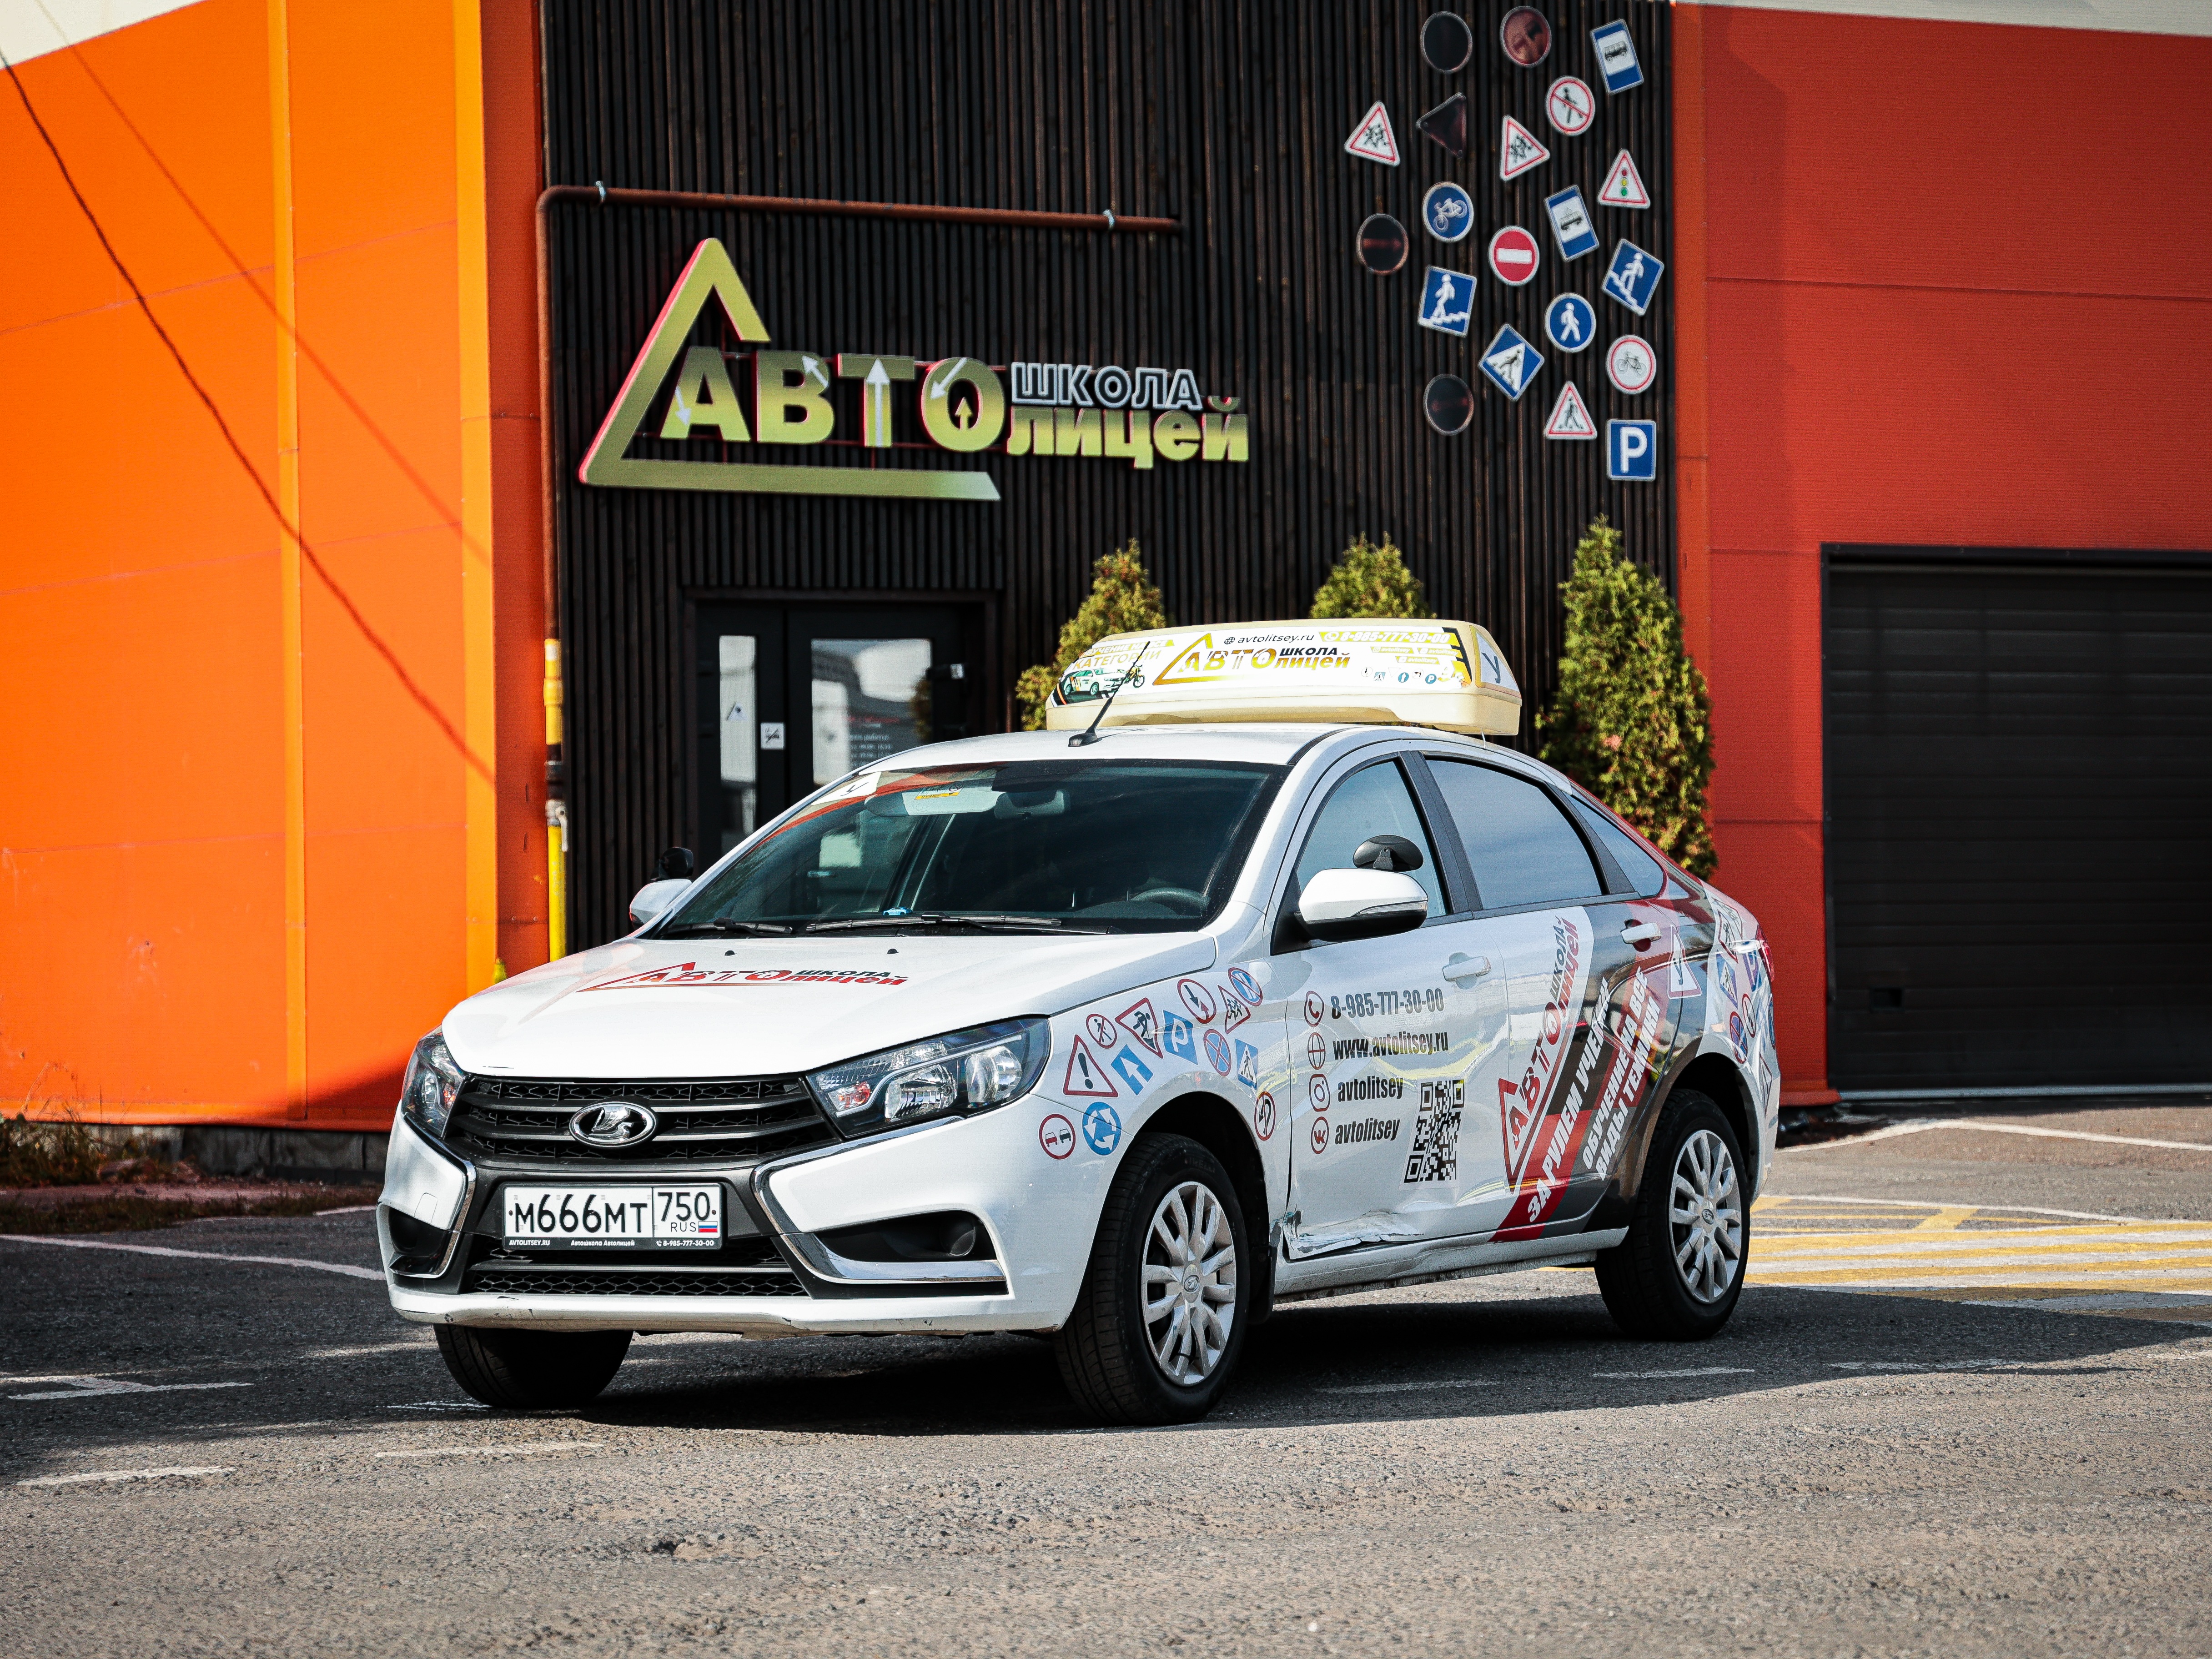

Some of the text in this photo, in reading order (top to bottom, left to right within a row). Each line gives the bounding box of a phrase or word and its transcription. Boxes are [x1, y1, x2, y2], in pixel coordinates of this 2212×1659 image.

[1012, 362, 1203, 410] ШКОЛА
[1620, 427, 1647, 473] P
[1238, 634, 1314, 644] avtolitsey.ru
[1279, 647, 1337, 656] ШКОЛА
[1072, 650, 1162, 670] КАТЕГОРИИ
[1550, 925, 1566, 1000] ШКОЛА
[1331, 988, 1444, 1020] 8-985-777-30-00
[1332, 1031, 1449, 1061] www.avtolitsey.ru
[1583, 965, 1648, 1170] ОБУЧЕНИЕ НА ВСЕ
[1337, 1076, 1404, 1102] avtolitsey
[1595, 995, 1660, 1181] ВИДЫ ТЕХНИКИ
[1335, 1117, 1401, 1145] avtolitsey
[1528, 1179, 1551, 1222] ЗА
[1542, 1082, 1583, 1185] РУЛЕМ
[514, 1191, 710, 1233] М666МТ 750
[670, 1222, 696, 1232] RUS
